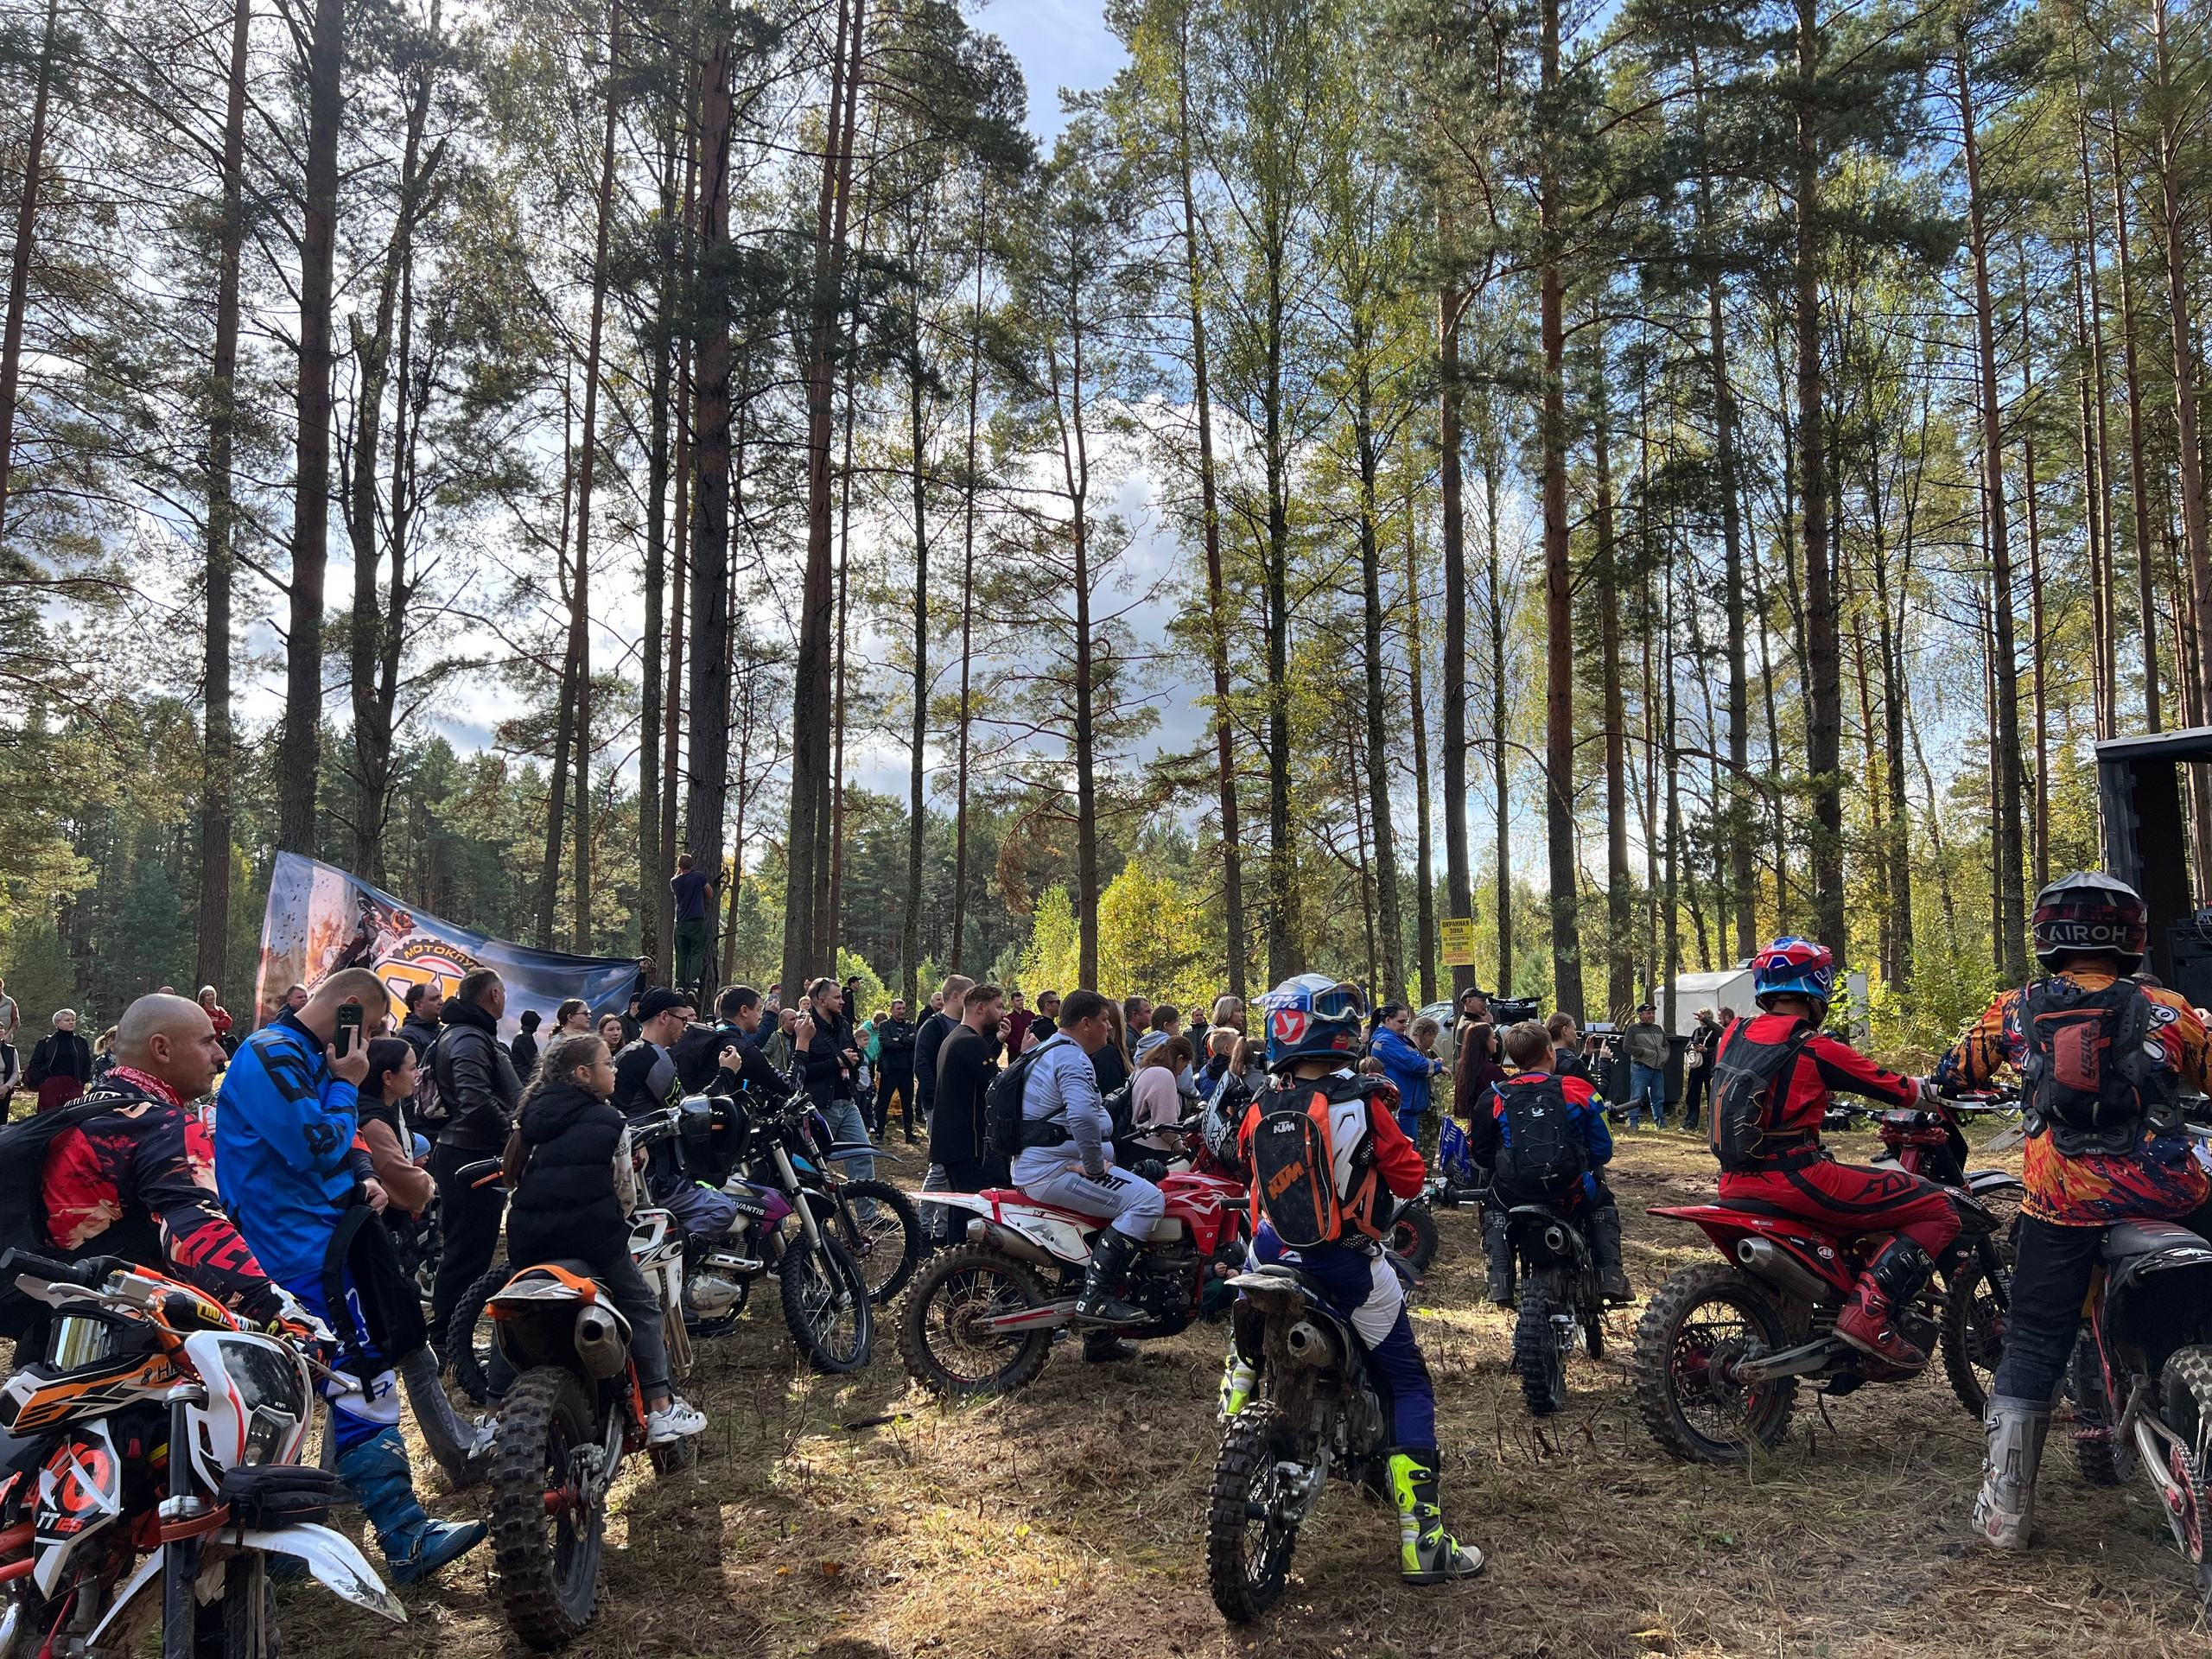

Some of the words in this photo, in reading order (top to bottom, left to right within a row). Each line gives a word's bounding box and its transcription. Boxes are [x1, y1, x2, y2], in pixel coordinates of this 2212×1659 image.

[1442, 919, 1470, 928] ОХРАННАЯ
[2049, 925, 2127, 943] AIROH
[1274, 1121, 1295, 1134] KTM
[1268, 1160, 1306, 1200] KTM
